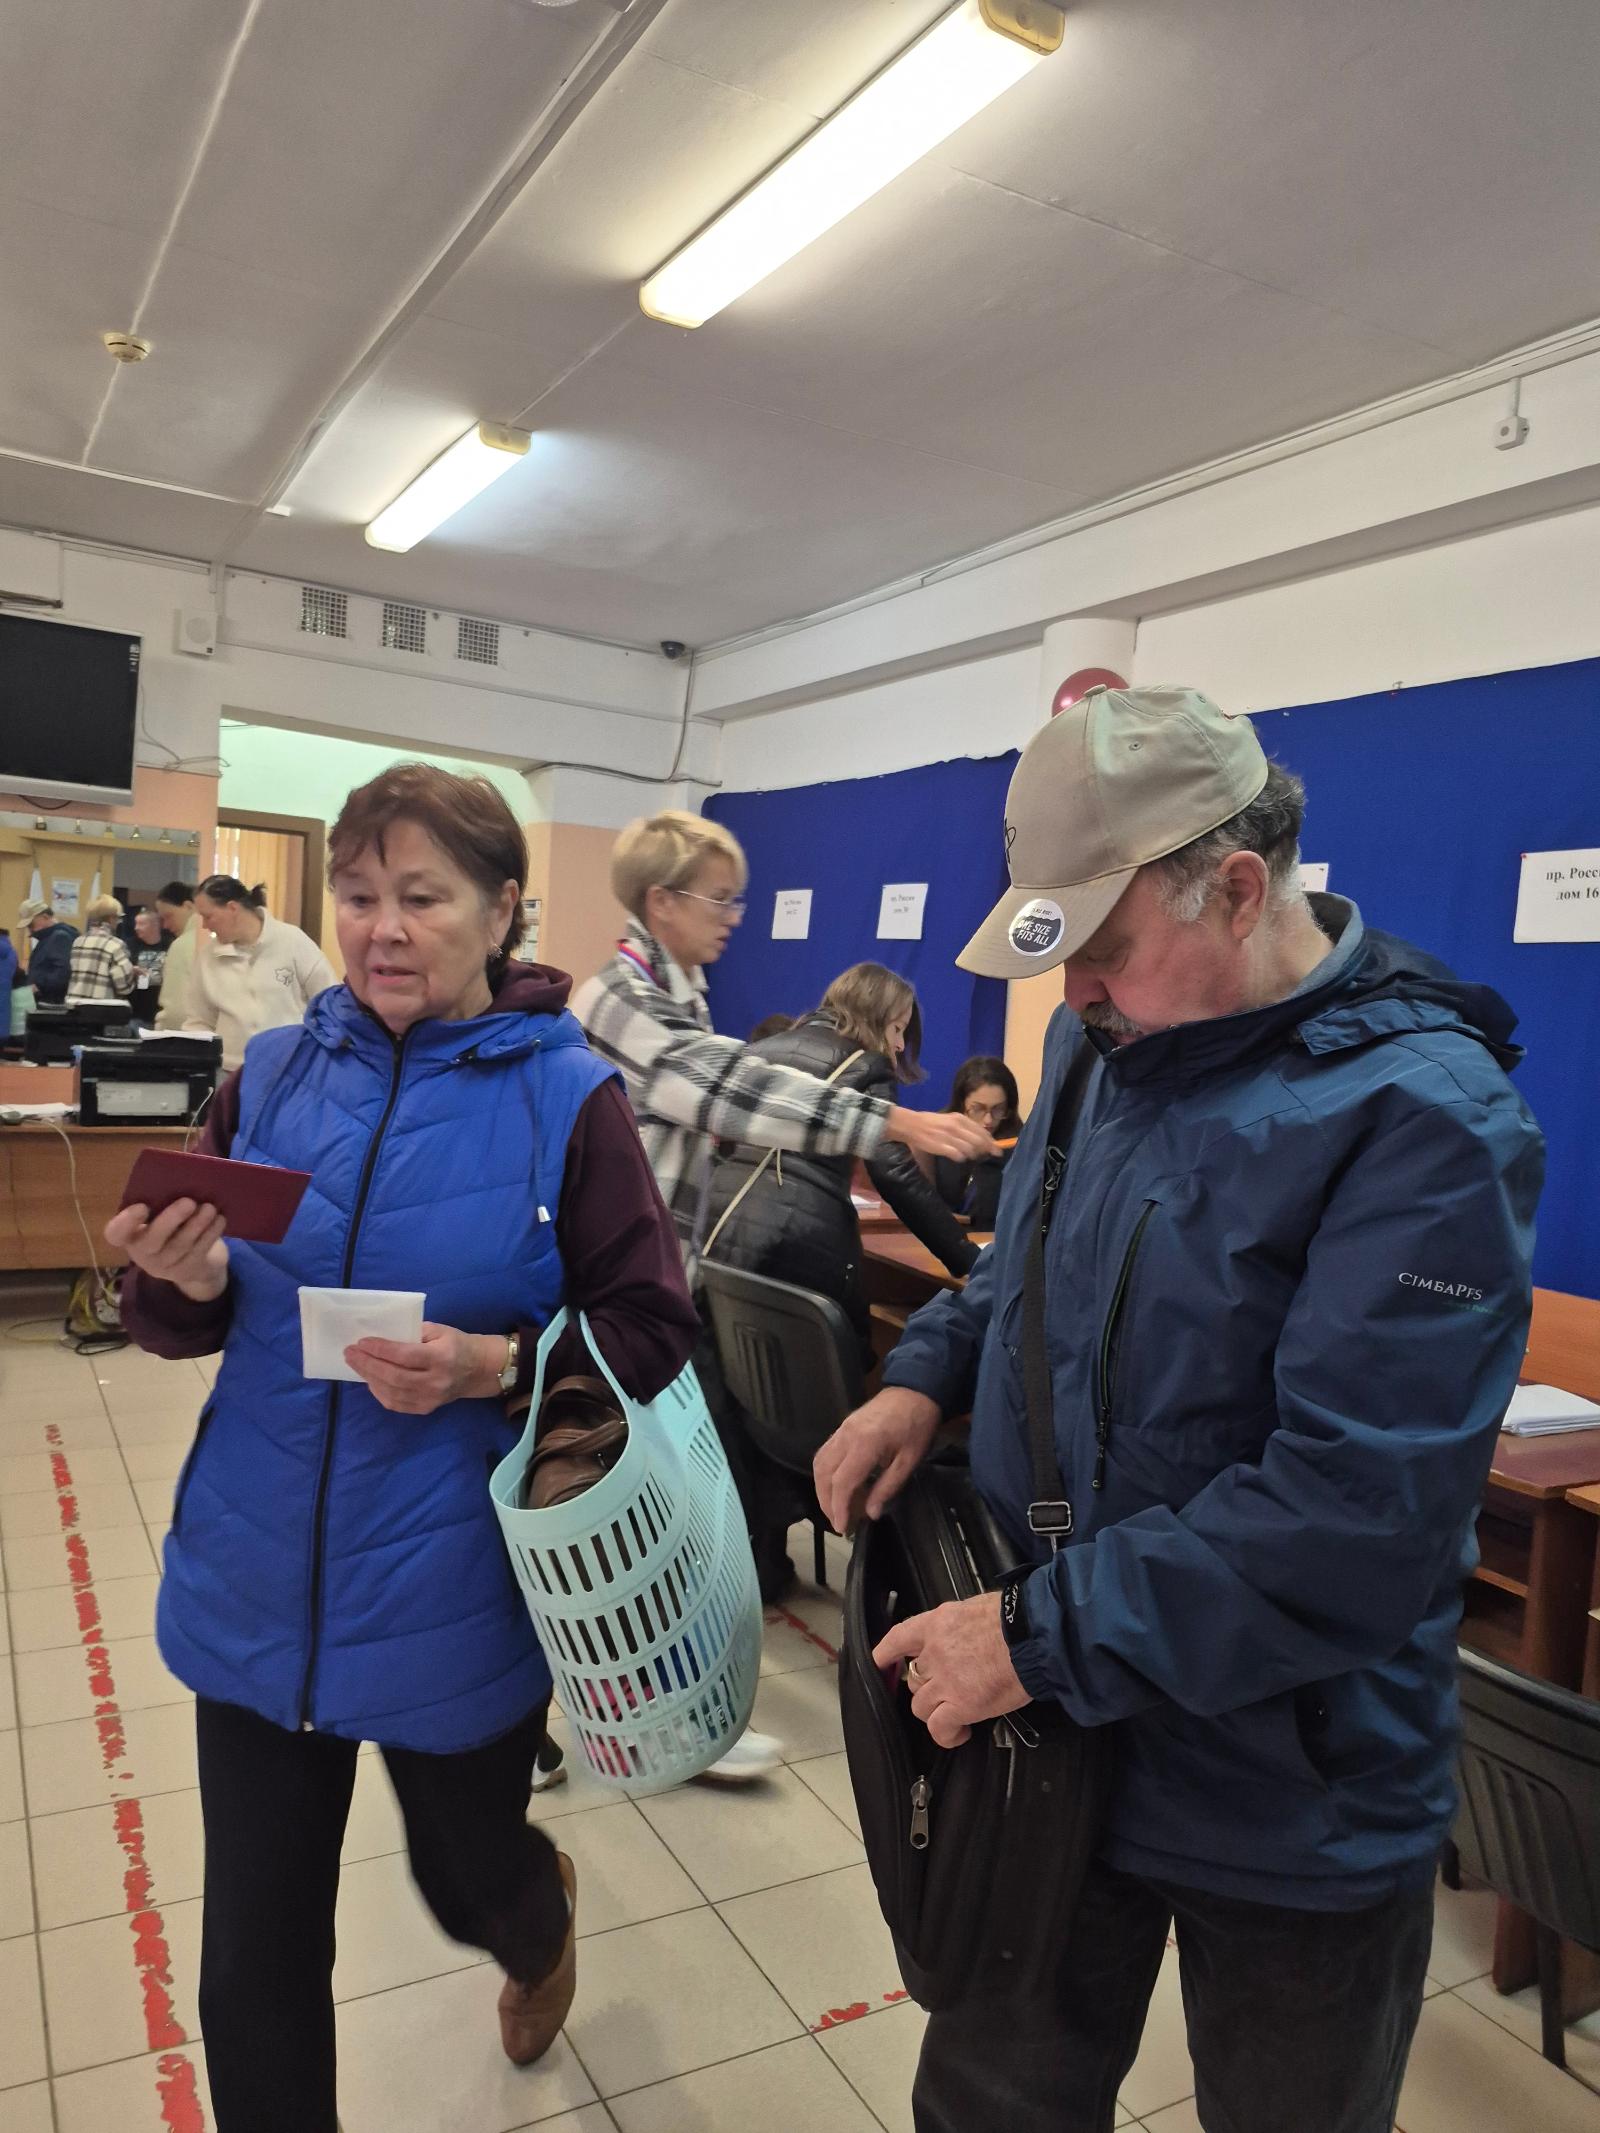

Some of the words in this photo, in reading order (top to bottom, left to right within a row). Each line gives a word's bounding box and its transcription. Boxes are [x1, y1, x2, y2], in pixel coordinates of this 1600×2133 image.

[1546, 871, 1565, 883] пр.
[1570, 867, 1600, 879] Росс
[1556, 890, 1580, 900] дом
[1033, 924, 1052, 935] SIZE
[1017, 929, 1035, 941] FITS
[1033, 934, 1049, 945] ALL
